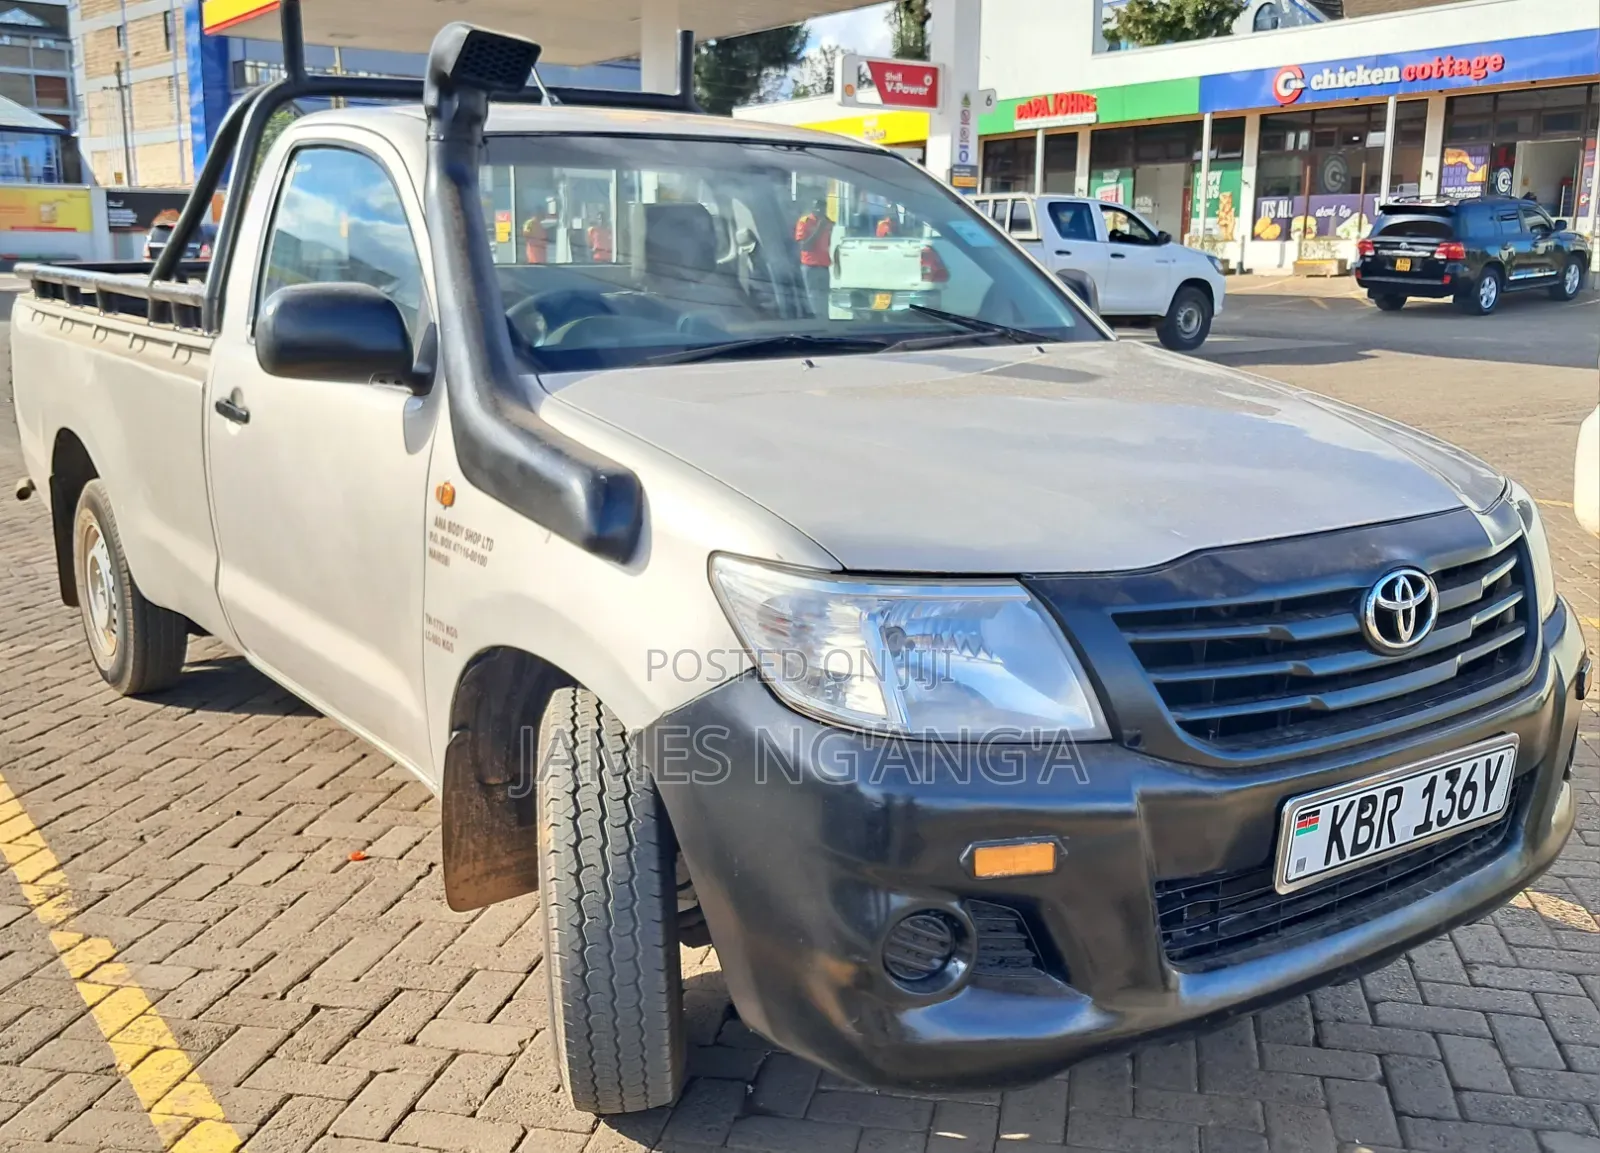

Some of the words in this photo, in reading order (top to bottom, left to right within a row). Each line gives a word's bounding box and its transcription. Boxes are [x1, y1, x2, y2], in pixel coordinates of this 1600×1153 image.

[884, 72, 903, 82] Shell
[1310, 64, 1401, 91] chicken
[1402, 54, 1504, 81] cottage
[885, 81, 930, 96] V-Power
[985, 95, 993, 107] 6
[1015, 96, 1051, 120] PAPA
[1052, 92, 1098, 116] JOHNS
[1277, 199, 1293, 218] ALL
[447, 520, 465, 538] BODY
[464, 528, 482, 546] SHOP
[481, 535, 494, 552] LTD
[1323, 786, 1404, 866] KBR
[1412, 754, 1505, 837] 136Y
